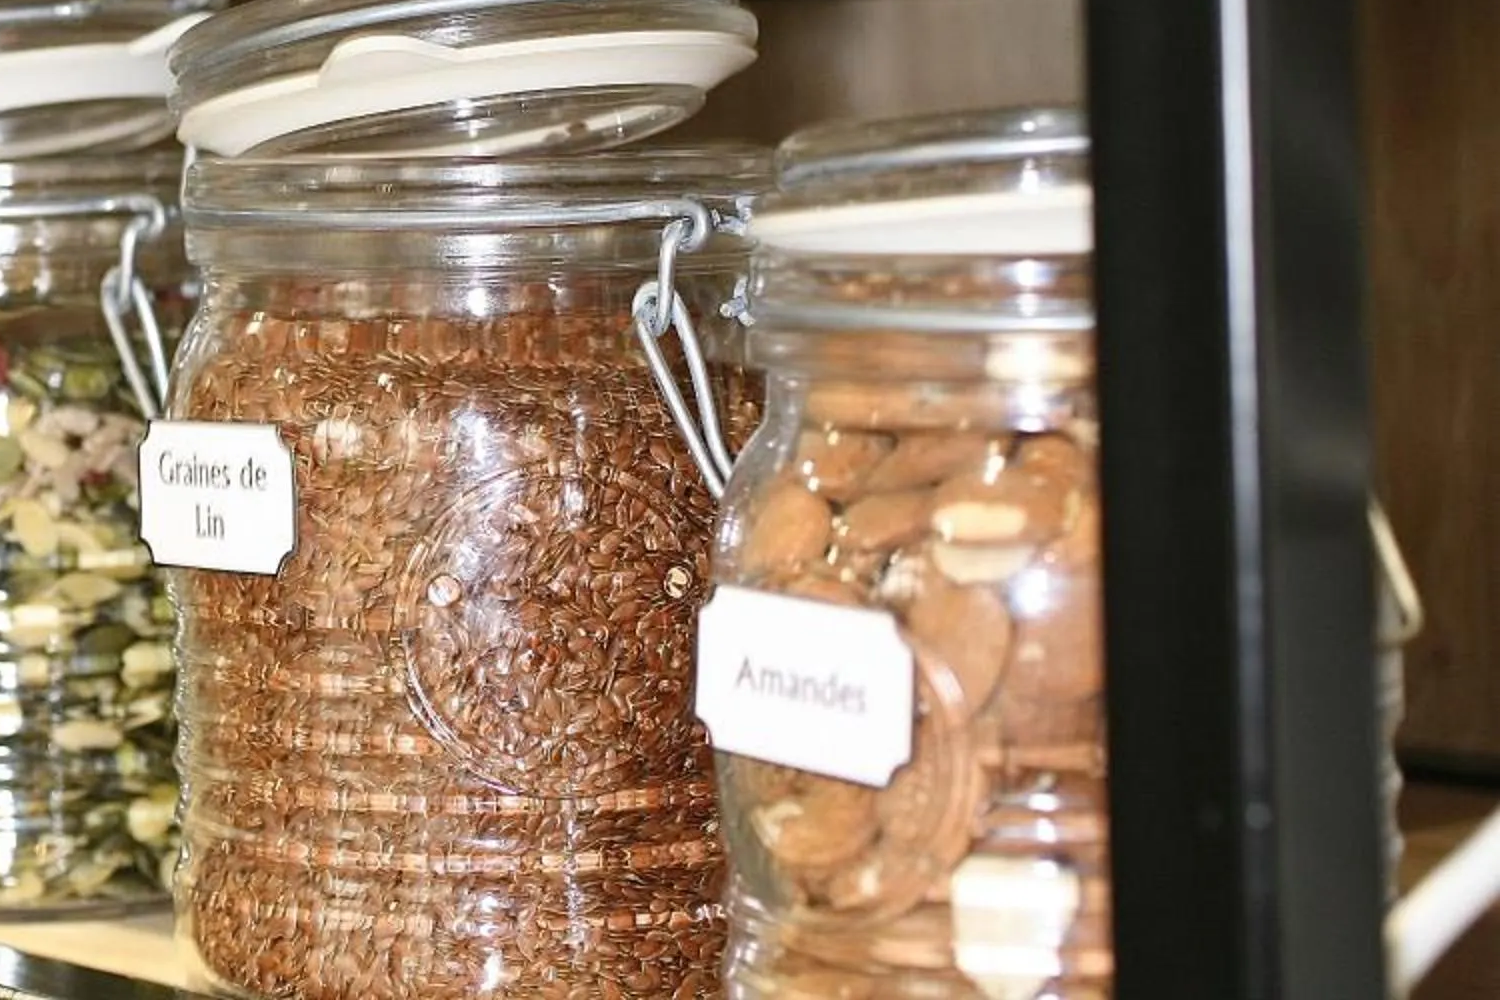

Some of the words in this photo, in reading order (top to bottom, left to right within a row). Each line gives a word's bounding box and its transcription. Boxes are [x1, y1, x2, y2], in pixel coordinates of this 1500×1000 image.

[158, 451, 232, 490] Graines
[240, 456, 268, 491] de
[195, 503, 226, 540] Lin
[734, 655, 867, 715] Amandes
